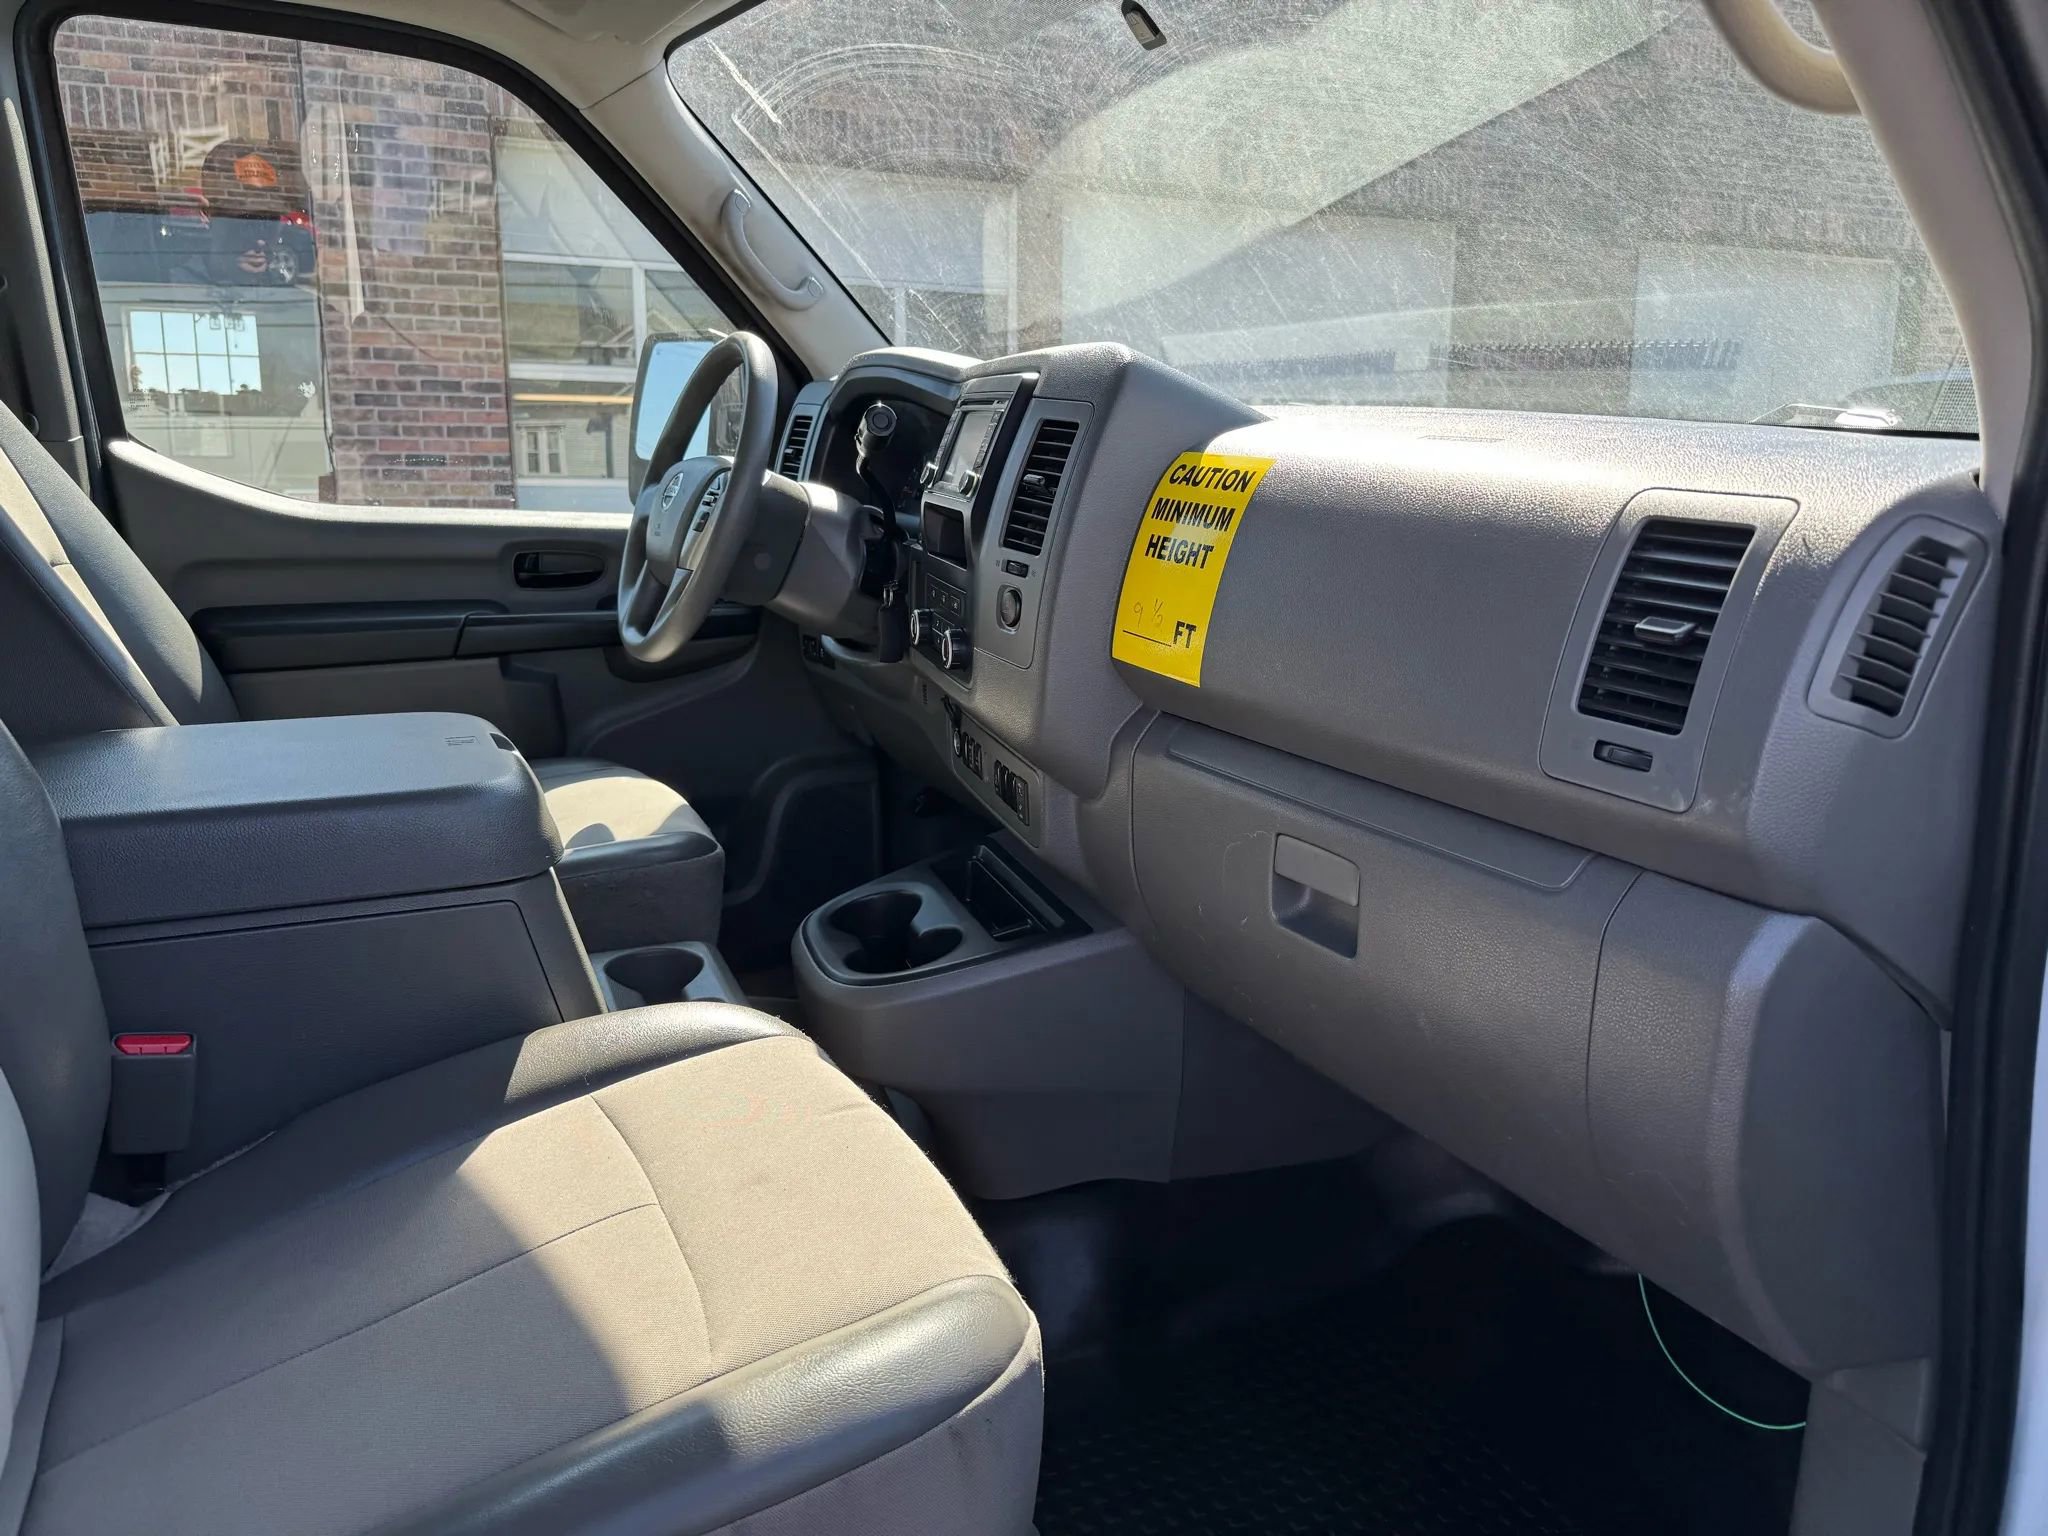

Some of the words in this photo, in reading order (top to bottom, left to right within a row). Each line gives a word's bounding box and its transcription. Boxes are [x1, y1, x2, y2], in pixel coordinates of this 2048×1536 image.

[1169, 464, 1257, 492] CAUTION
[1151, 497, 1236, 532] MINIMUM
[1145, 534, 1215, 569] HEIGHT
[1133, 601, 1144, 628] 9
[1173, 620, 1198, 649] FT
